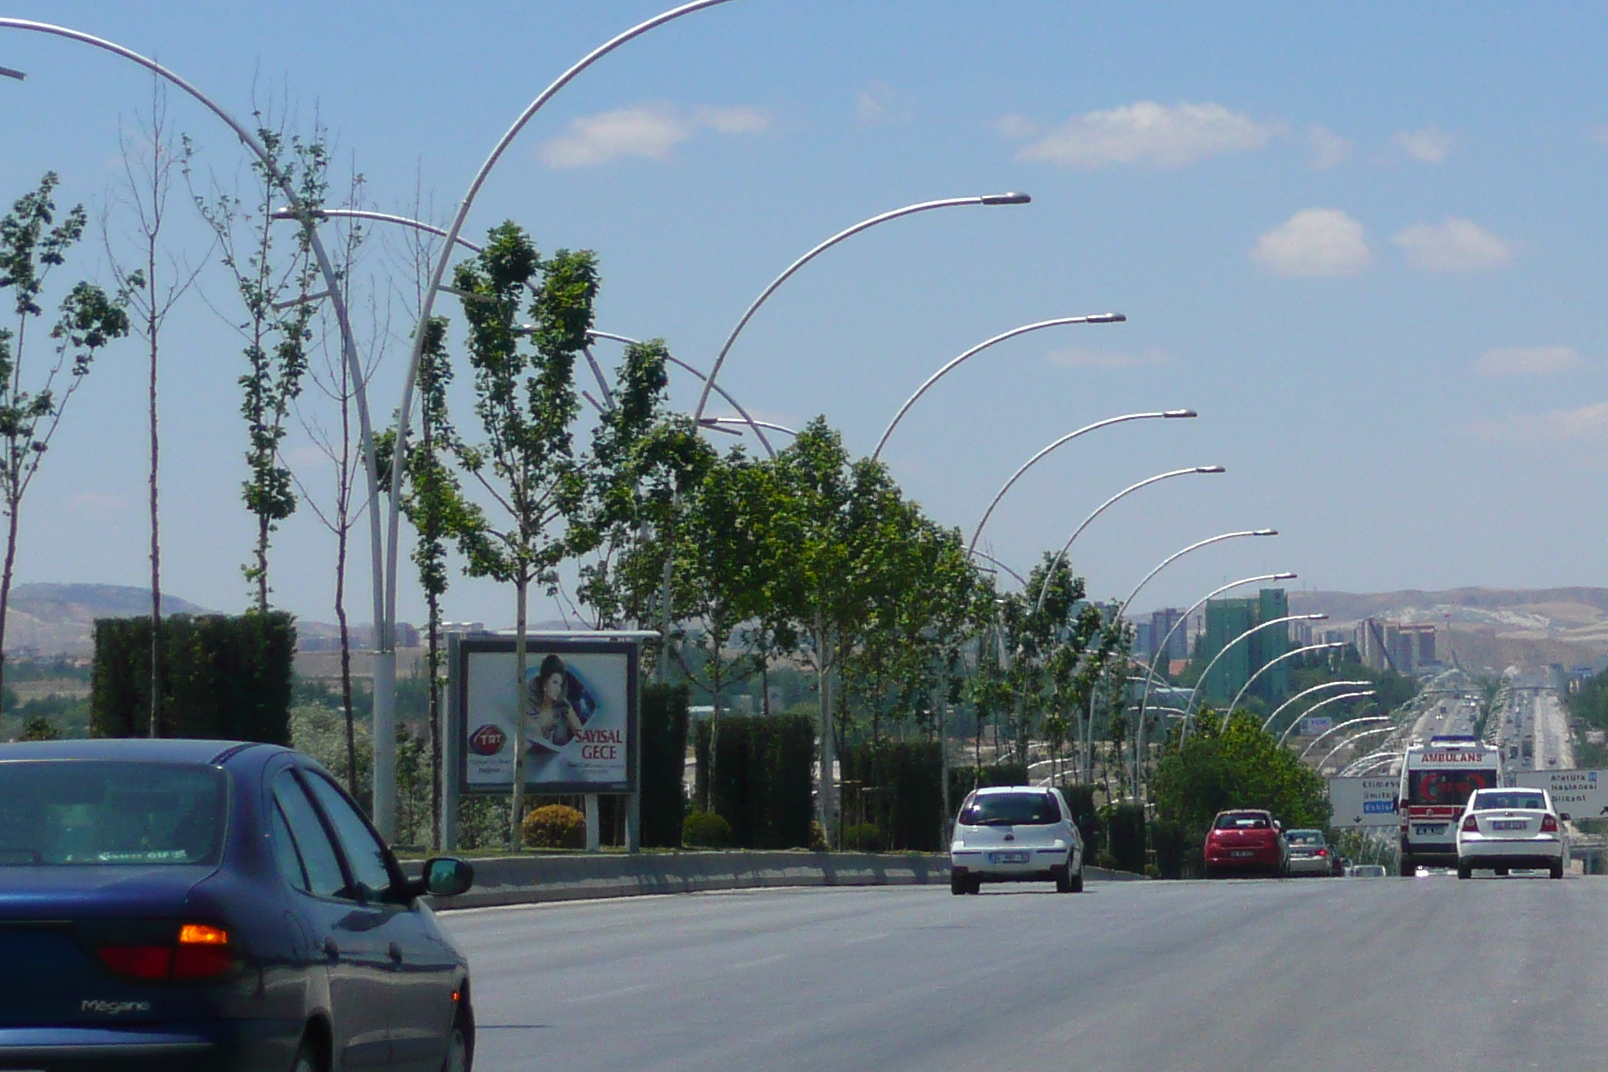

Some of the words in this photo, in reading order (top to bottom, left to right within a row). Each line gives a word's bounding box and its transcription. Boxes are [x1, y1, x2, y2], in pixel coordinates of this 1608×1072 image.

[575, 729, 622, 744] SAYISAL
[581, 745, 617, 760] GECE
[1421, 753, 1483, 763] AMBULANS
